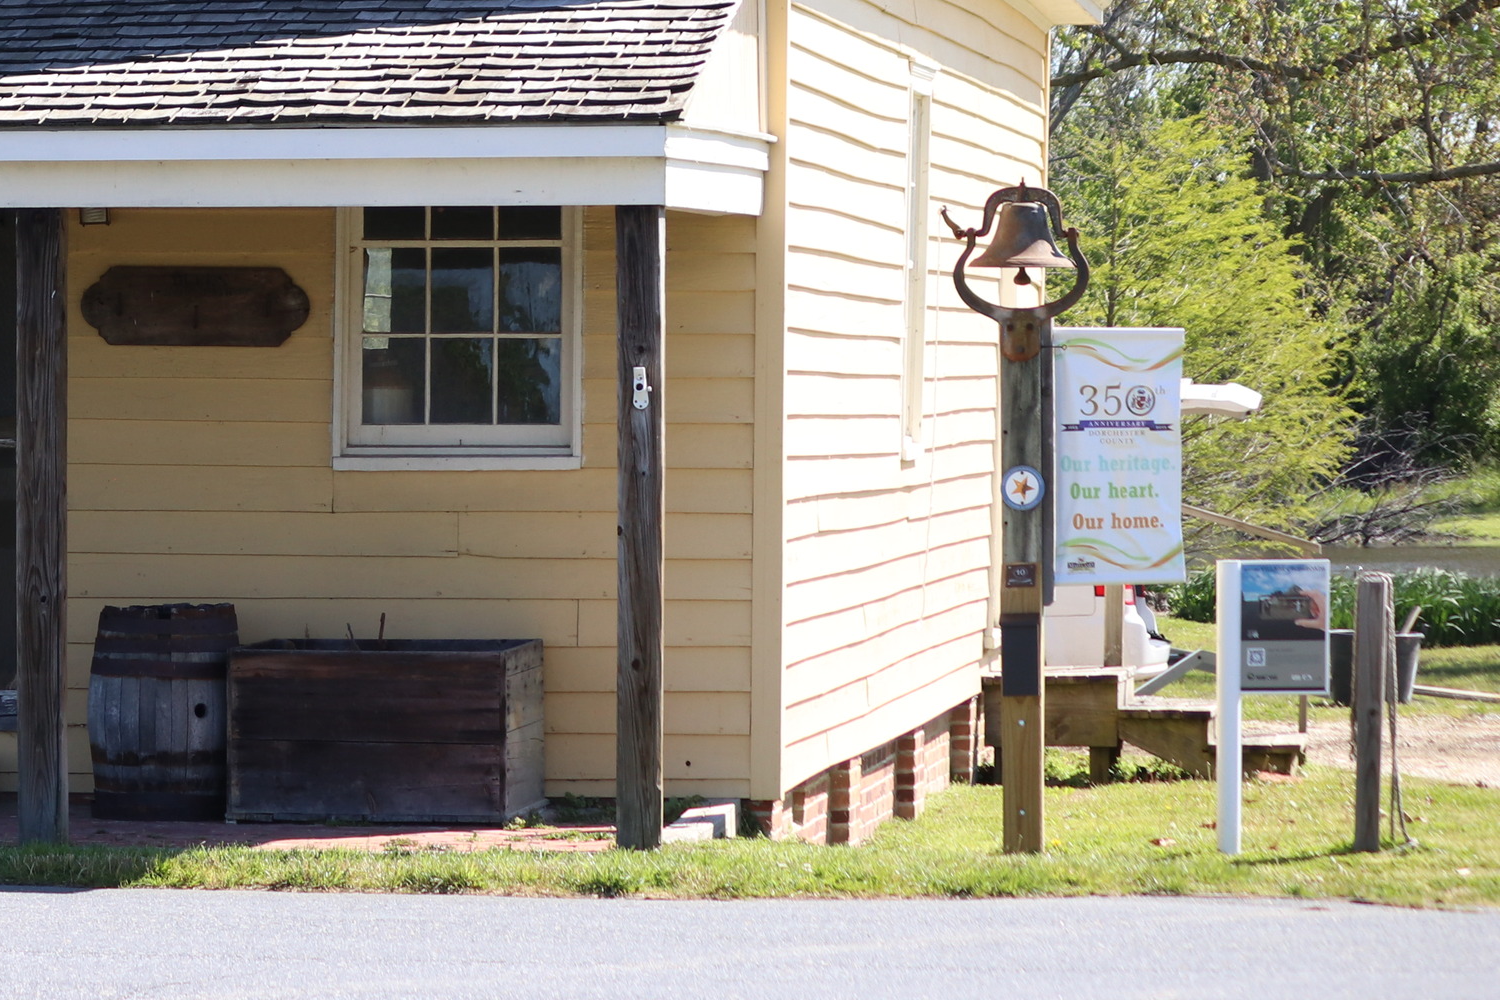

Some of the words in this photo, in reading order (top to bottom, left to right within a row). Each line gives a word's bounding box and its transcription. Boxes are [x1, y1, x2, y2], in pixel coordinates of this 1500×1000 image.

[1088, 420, 1147, 428] ANNIVERSARY
[1088, 429, 1146, 437] DORCHESTER
[1060, 454, 1092, 473] Our
[1098, 453, 1176, 476] heritage.
[1070, 482, 1101, 500] Our
[1107, 482, 1159, 499] heart.
[1072, 513, 1105, 530] Our
[1111, 512, 1165, 529] home.
